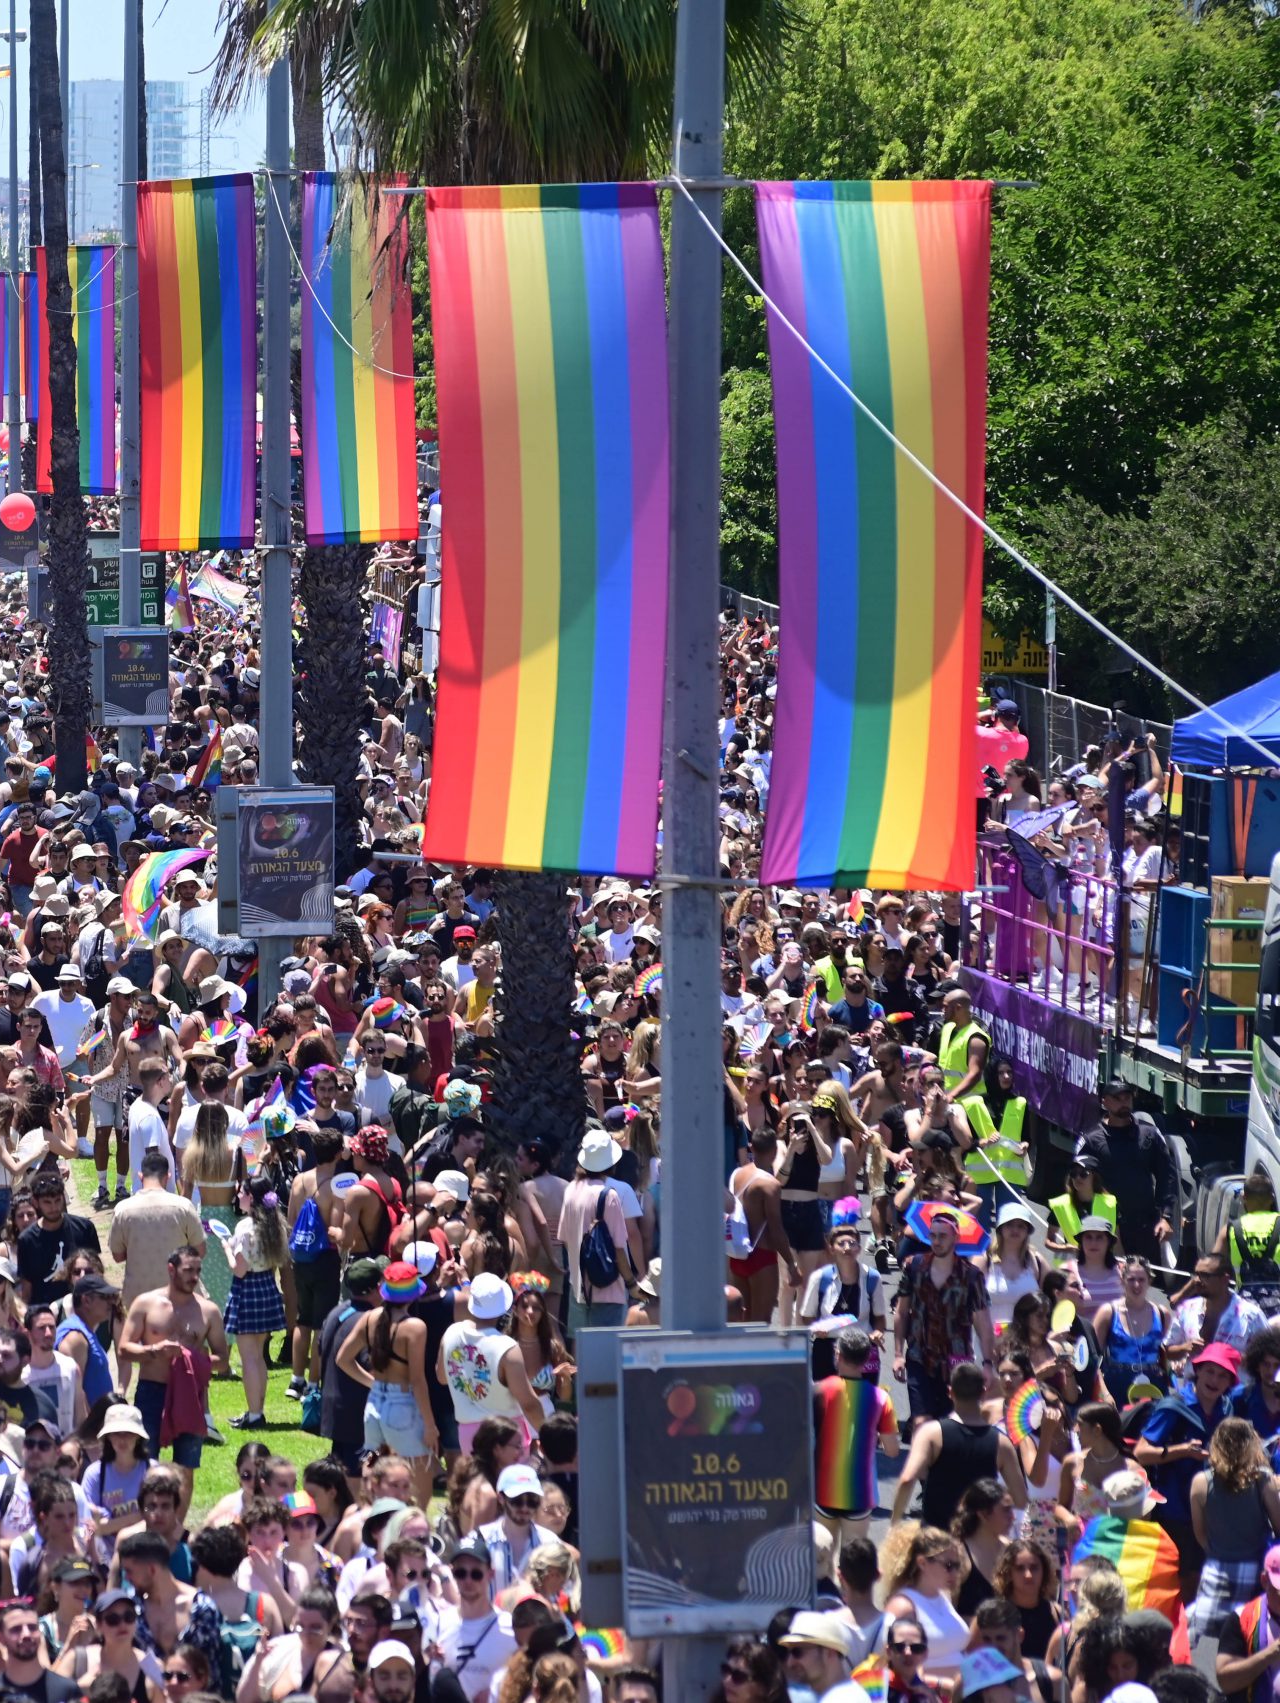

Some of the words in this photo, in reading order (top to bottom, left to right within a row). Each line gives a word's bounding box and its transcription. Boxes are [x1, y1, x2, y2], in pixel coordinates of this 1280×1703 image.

[127, 664, 145, 672] 10.6
[111, 673, 139, 682] הגאווה
[140, 673, 161, 681] מצעד
[275, 847, 300, 860] 10.6
[250, 861, 291, 875] הגאווה
[293, 860, 323, 873] מצעד
[995, 1016, 1015, 1057] STOP
[1016, 1025, 1030, 1065] THE
[715, 1391, 756, 1409] גאווה
[692, 1453, 741, 1475] 10.6
[645, 1480, 723, 1506] הגאווה
[729, 1478, 789, 1502] מצעד
